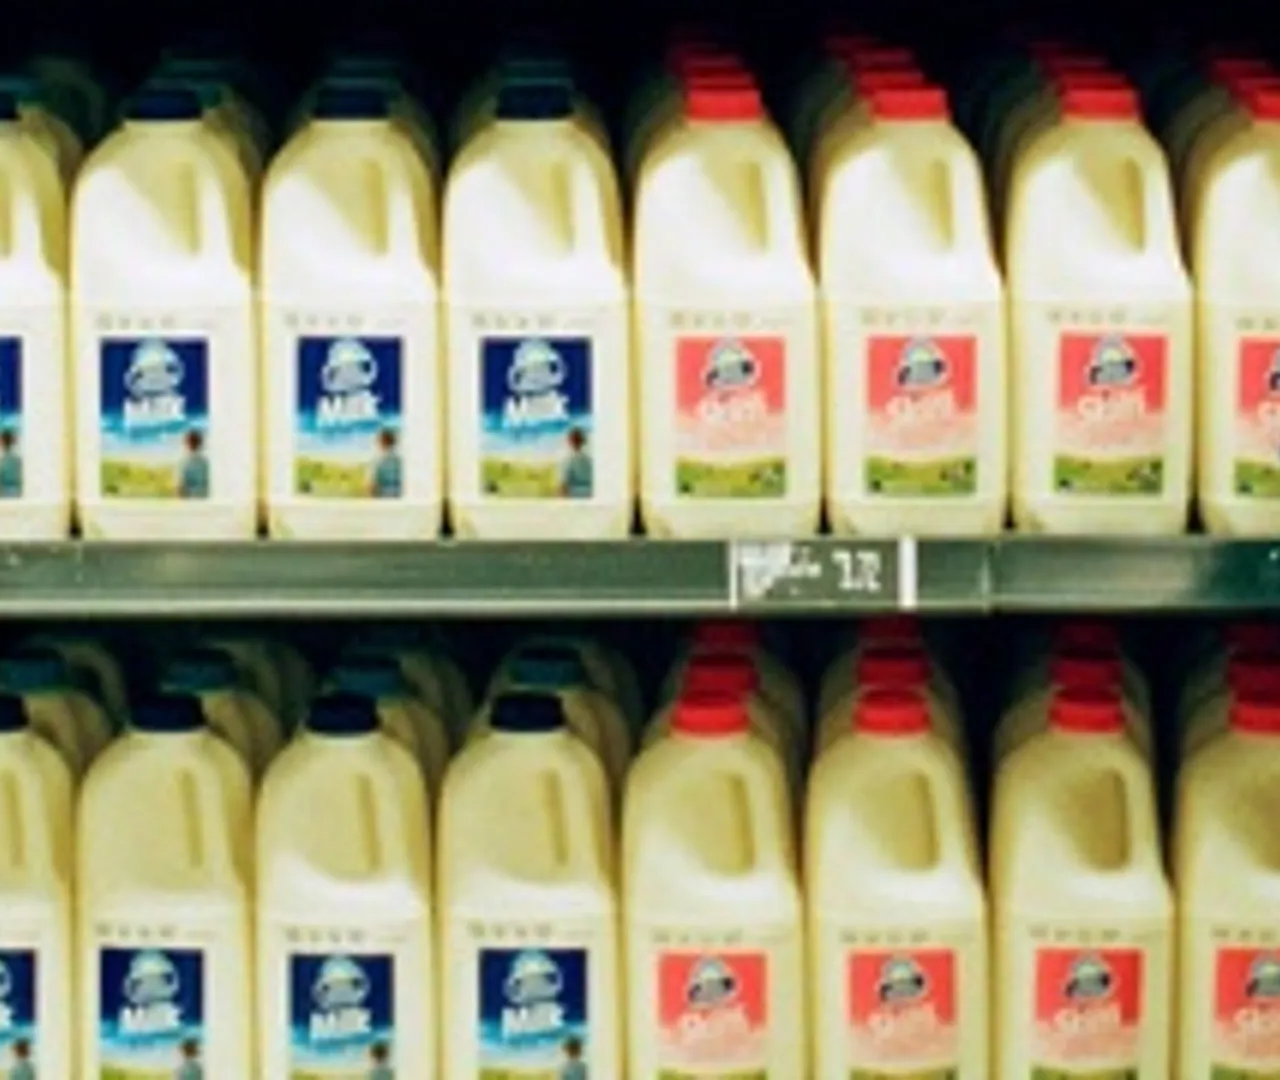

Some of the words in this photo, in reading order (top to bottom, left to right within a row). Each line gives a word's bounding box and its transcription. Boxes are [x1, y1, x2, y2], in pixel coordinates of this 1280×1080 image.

[123, 393, 185, 429] Milk
[317, 391, 378, 426] Milk
[504, 391, 568, 427] Milk
